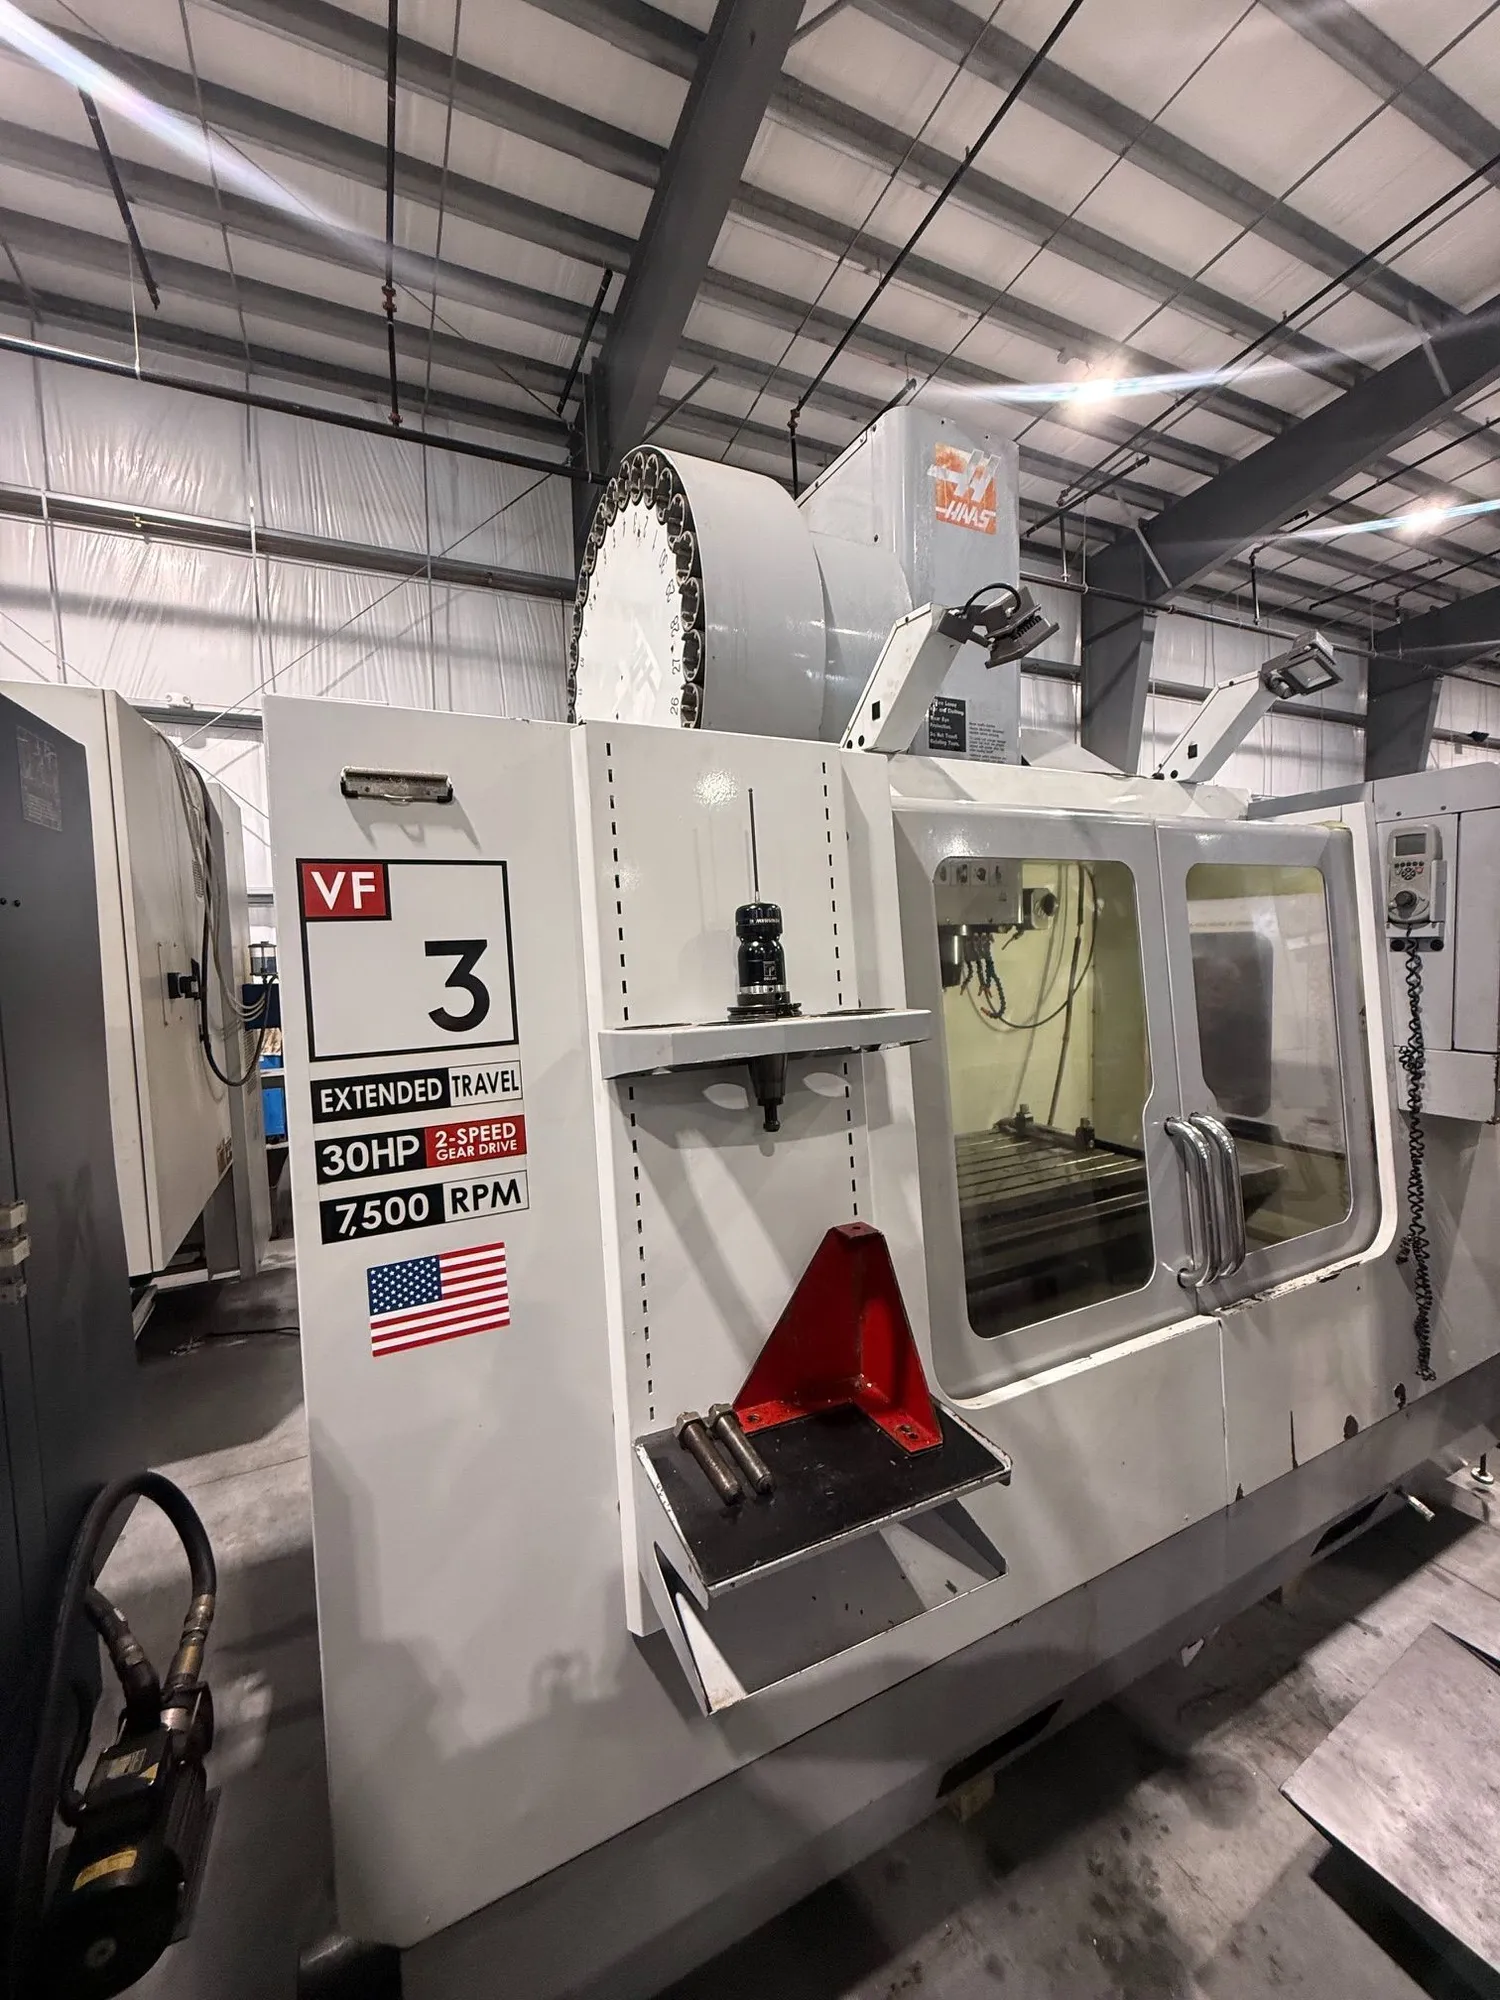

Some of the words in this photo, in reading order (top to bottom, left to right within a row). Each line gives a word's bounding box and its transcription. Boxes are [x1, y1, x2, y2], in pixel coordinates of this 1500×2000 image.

[936, 499, 996, 528] HAAS
[671, 659, 681, 675] 27
[669, 697, 680, 716] 26
[311, 871, 376, 910] VF
[425, 939, 490, 1032] 3
[320, 1077, 443, 1113] EXTENDED
[452, 1069, 520, 1098] TRAVEL
[322, 1134, 420, 1176] 30HP
[435, 1122, 516, 1148] 2-SPEED
[436, 1145, 476, 1161] GEAR
[478, 1138, 518, 1156] DRIVE
[334, 1192, 430, 1237] 7,500
[451, 1178, 522, 1216] RPM
